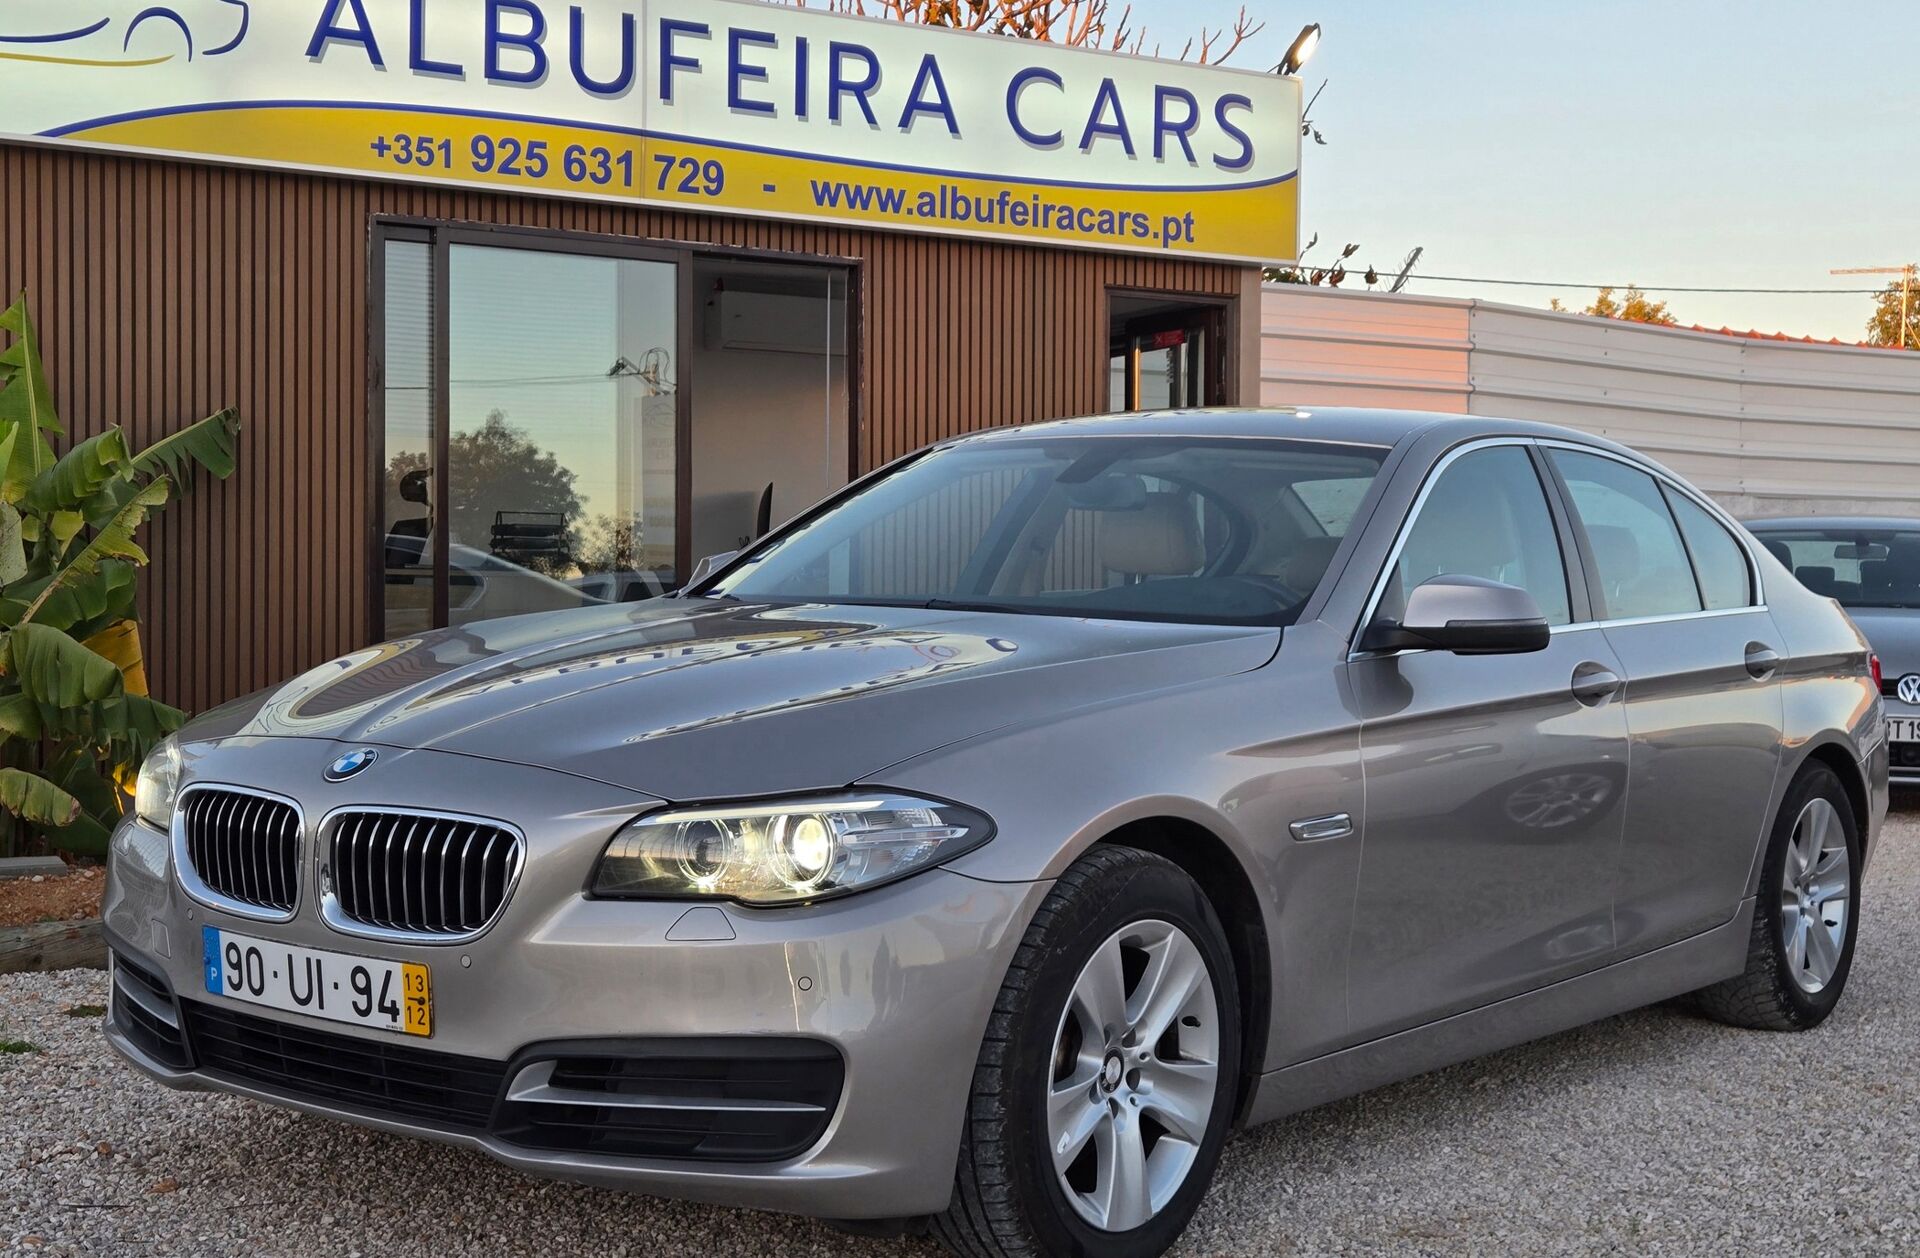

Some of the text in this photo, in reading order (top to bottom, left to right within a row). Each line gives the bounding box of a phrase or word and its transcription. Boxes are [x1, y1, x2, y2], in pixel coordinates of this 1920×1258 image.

[306, 0, 1252, 168] ALBUFEIRA CARS
[370, 133, 452, 169] +351
[471, 134, 549, 178] 925
[563, 144, 634, 188] 631
[654, 154, 725, 197] 729
[811, 180, 1195, 249] www.albufeiracars.pt
[210, 967, 218, 981] P
[405, 972, 424, 993] 13
[406, 1005, 426, 1027] 12
